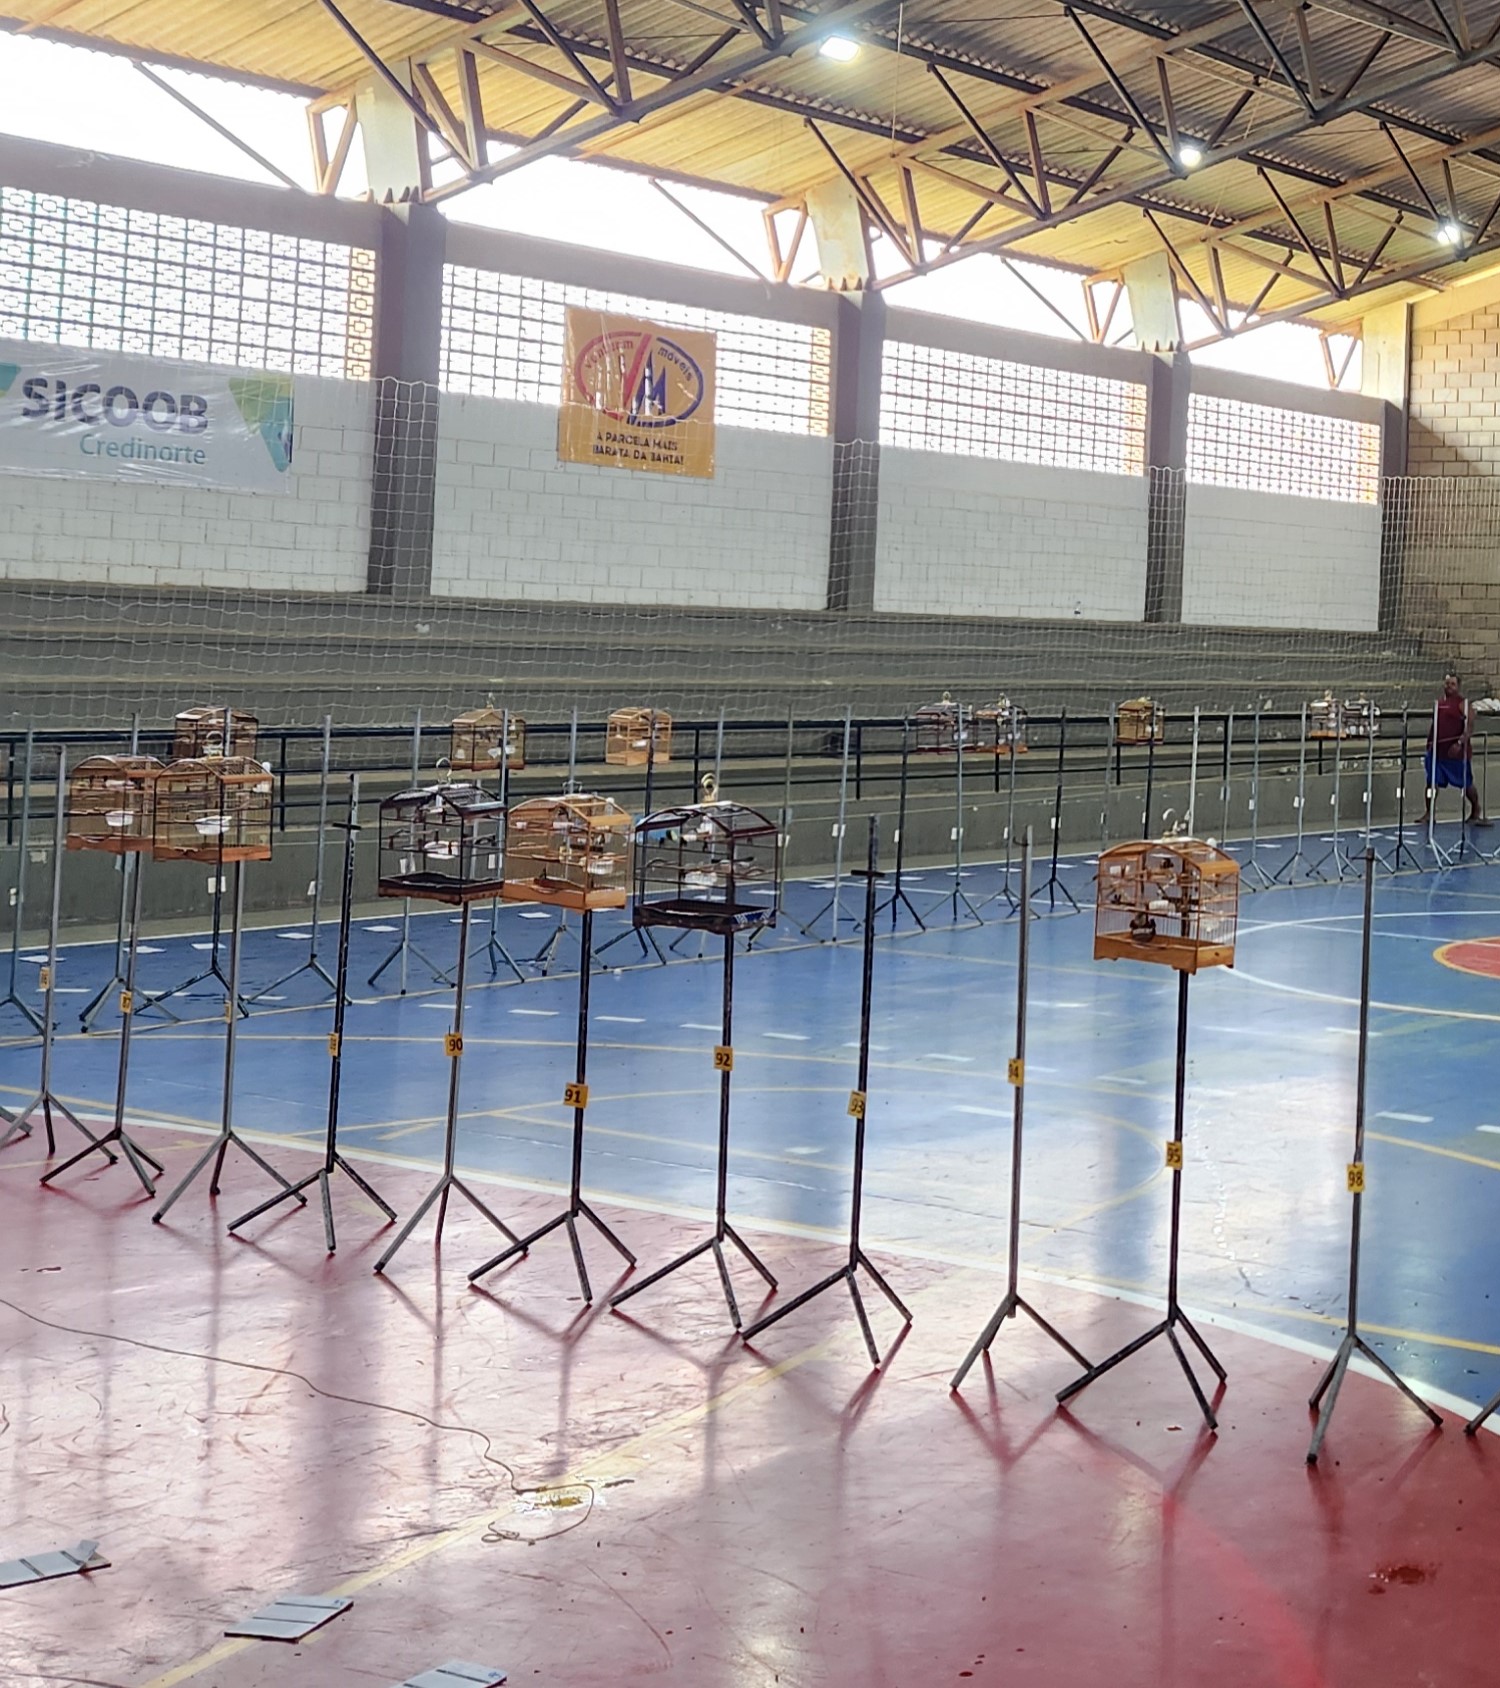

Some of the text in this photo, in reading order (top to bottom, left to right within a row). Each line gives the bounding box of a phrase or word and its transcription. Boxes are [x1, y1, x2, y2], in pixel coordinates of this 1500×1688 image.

[22, 377, 209, 434] SICOOB
[79, 433, 207, 465] Credinorte
[606, 432, 650, 447] PARCELA
[653, 440, 678, 451] MAIS
[593, 444, 629, 457] BARATA
[633, 449, 647, 460] DA
[449, 1037, 463, 1051] 90
[716, 1052, 731, 1067] 92
[564, 1088, 581, 1103] 91
[851, 1098, 863, 1113] 93
[1348, 1171, 1363, 1187] 98
